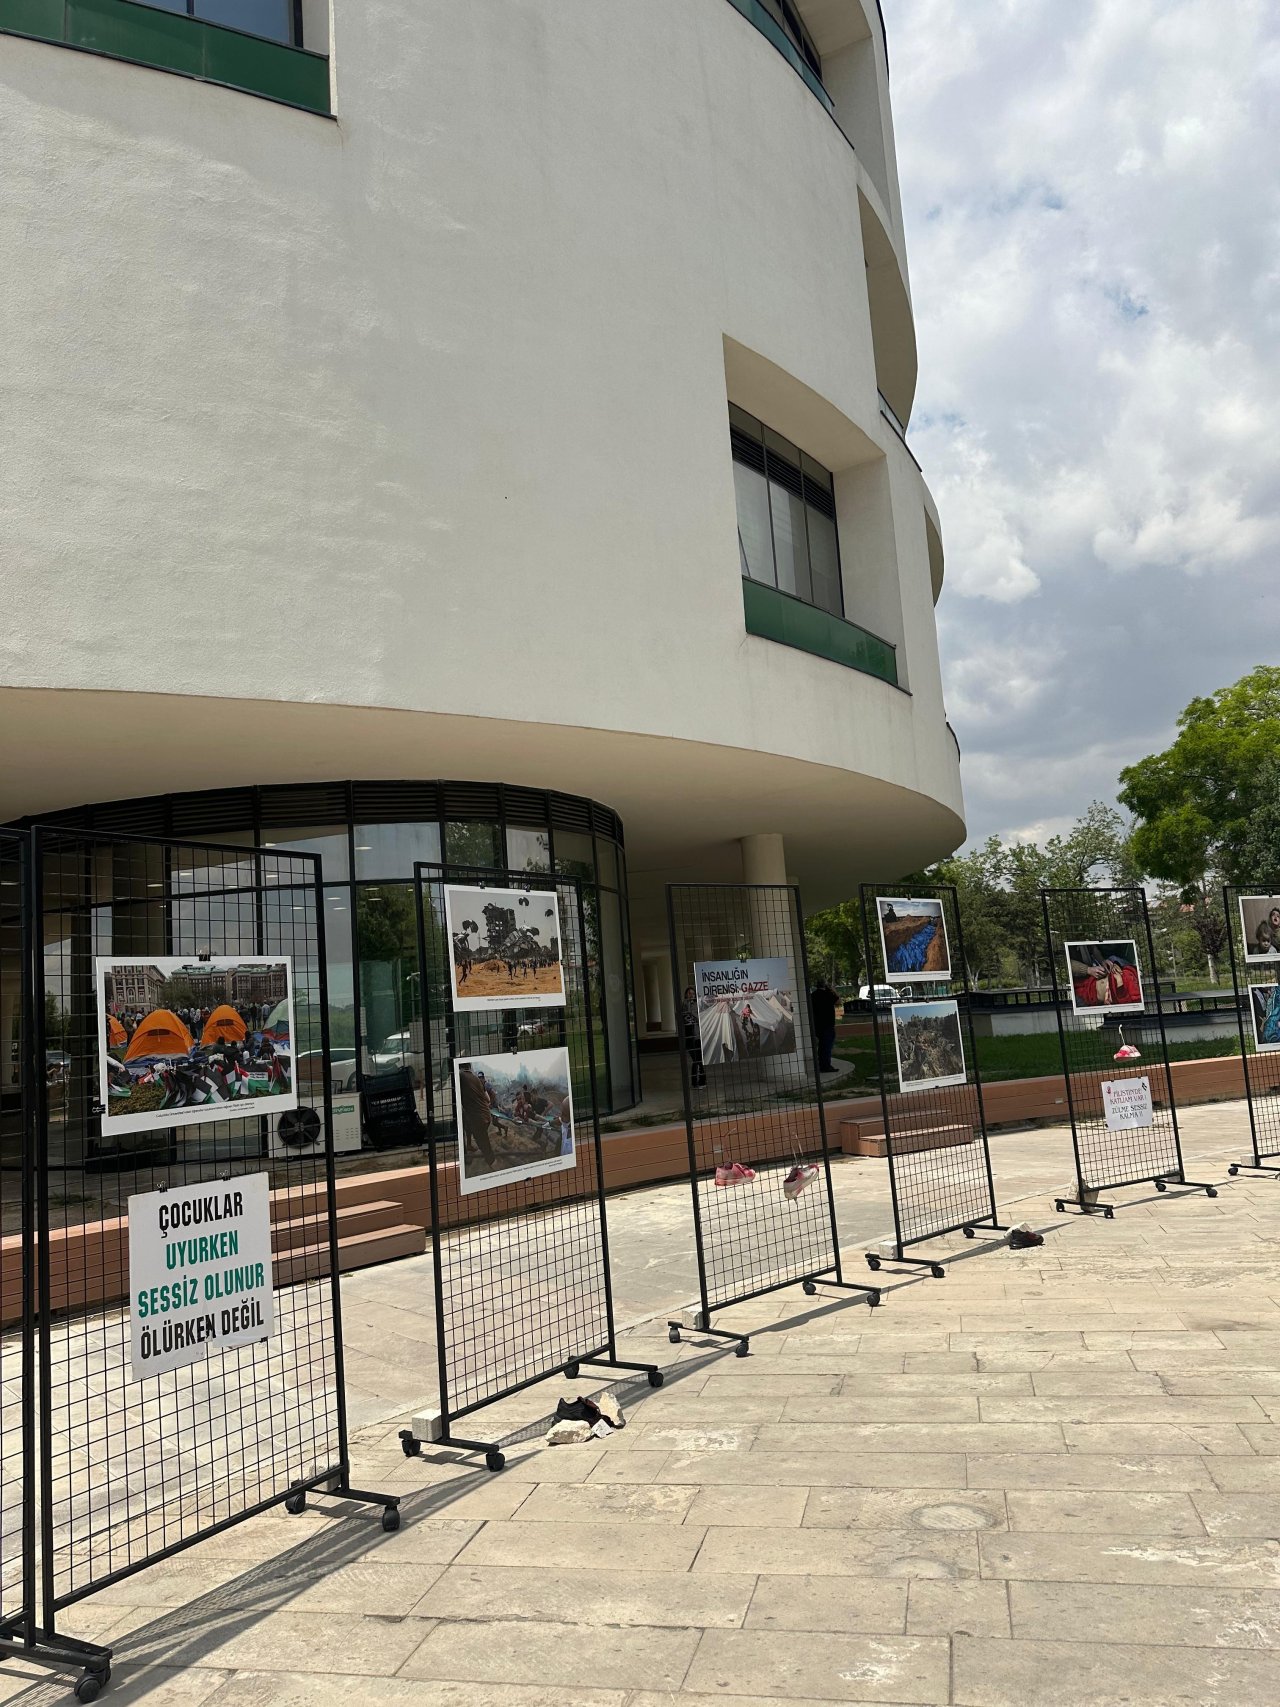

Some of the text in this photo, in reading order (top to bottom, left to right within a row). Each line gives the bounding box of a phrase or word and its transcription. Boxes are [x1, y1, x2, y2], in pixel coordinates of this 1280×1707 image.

[701, 966, 749, 983] İNSANLIĞIN
[741, 981, 769, 993] GAZZE
[159, 1191, 243, 1239] ÇOCUKLAR
[166, 1229, 239, 1270] UYURKEN
[138, 1262, 264, 1319] SESSİZ OLUNUR
[140, 1297, 264, 1360] ÖLÜRKEN DEĞİL
